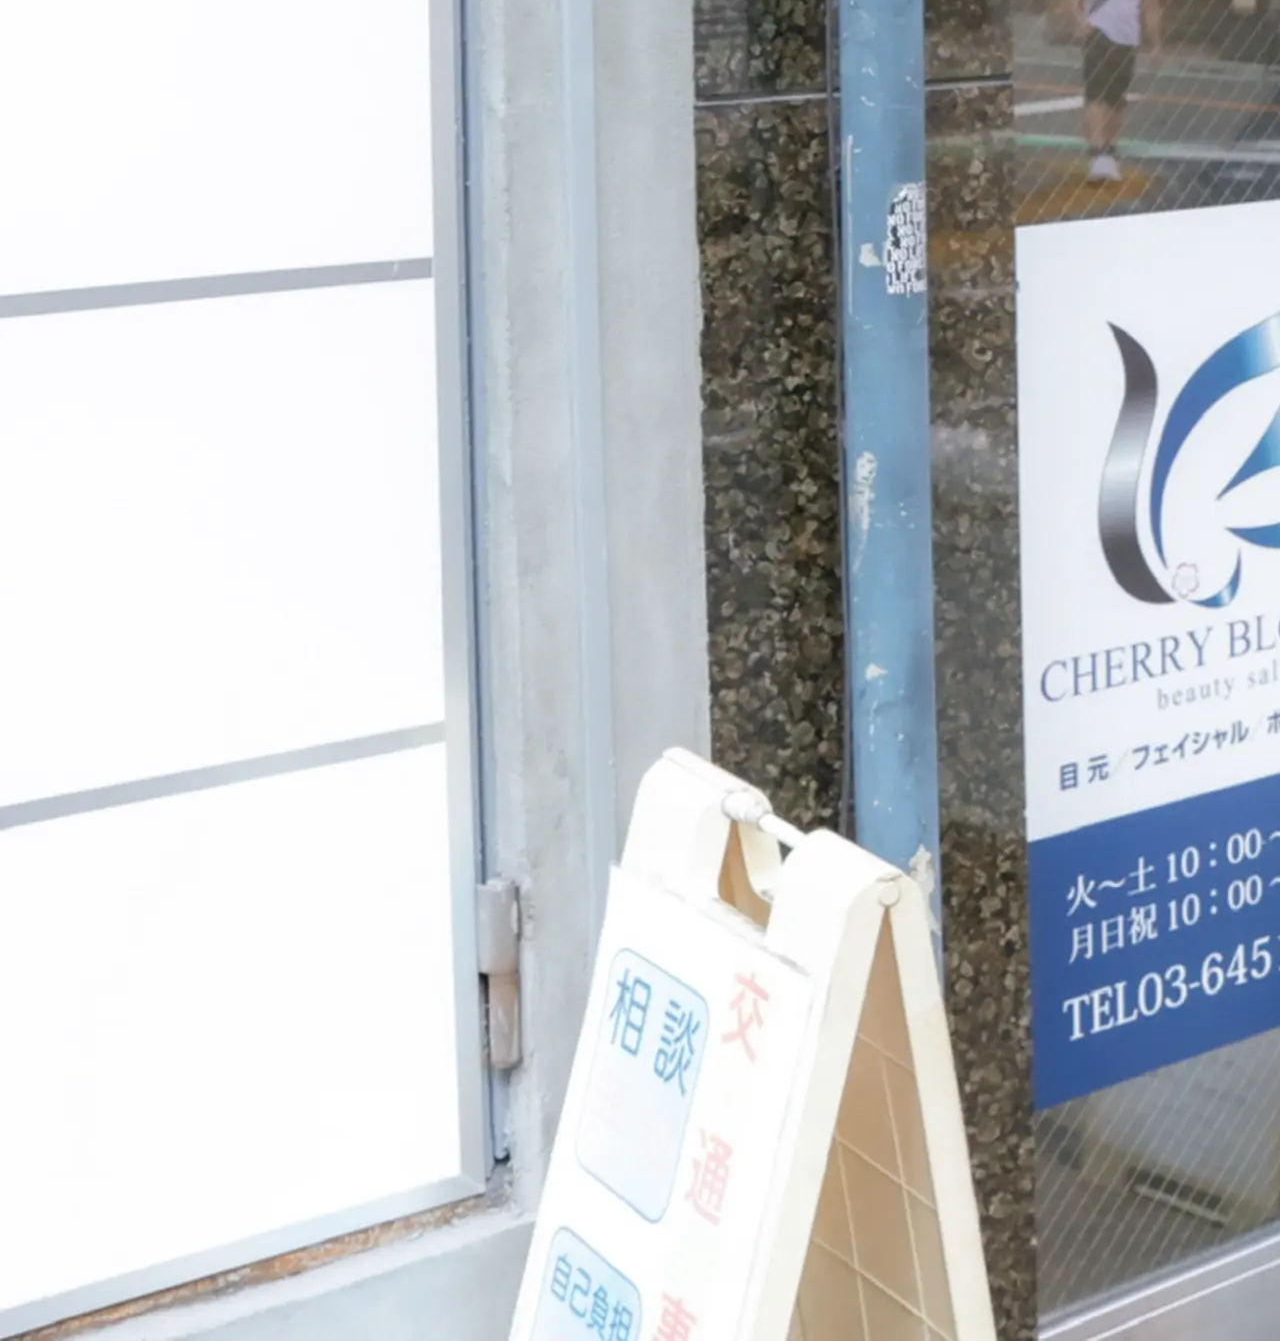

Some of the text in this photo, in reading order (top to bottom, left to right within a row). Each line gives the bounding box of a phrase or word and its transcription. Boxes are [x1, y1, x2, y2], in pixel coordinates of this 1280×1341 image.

[1039, 625, 1215, 703] CHERRY
[1155, 674, 1236, 711] beauty
[1068, 903, 1159, 964] 月日祝
[609, 968, 702, 1097] 相談
[551, 1253, 634, 1341] 自己負担
